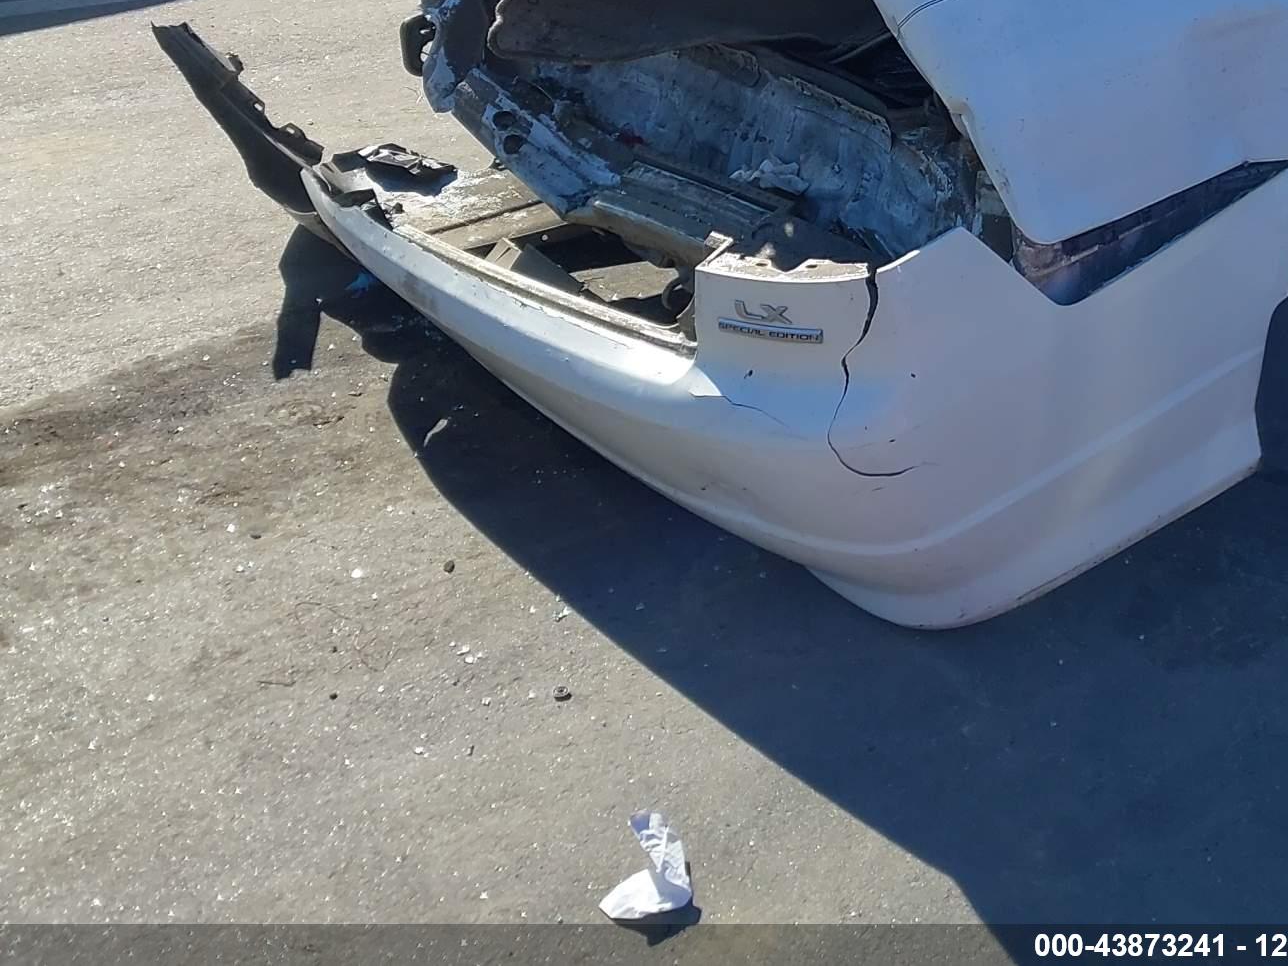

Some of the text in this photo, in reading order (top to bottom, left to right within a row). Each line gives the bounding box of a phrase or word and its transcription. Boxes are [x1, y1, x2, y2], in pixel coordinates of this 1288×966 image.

[735, 299, 793, 325] LX
[718, 321, 821, 342] SPECIAL EDITION
